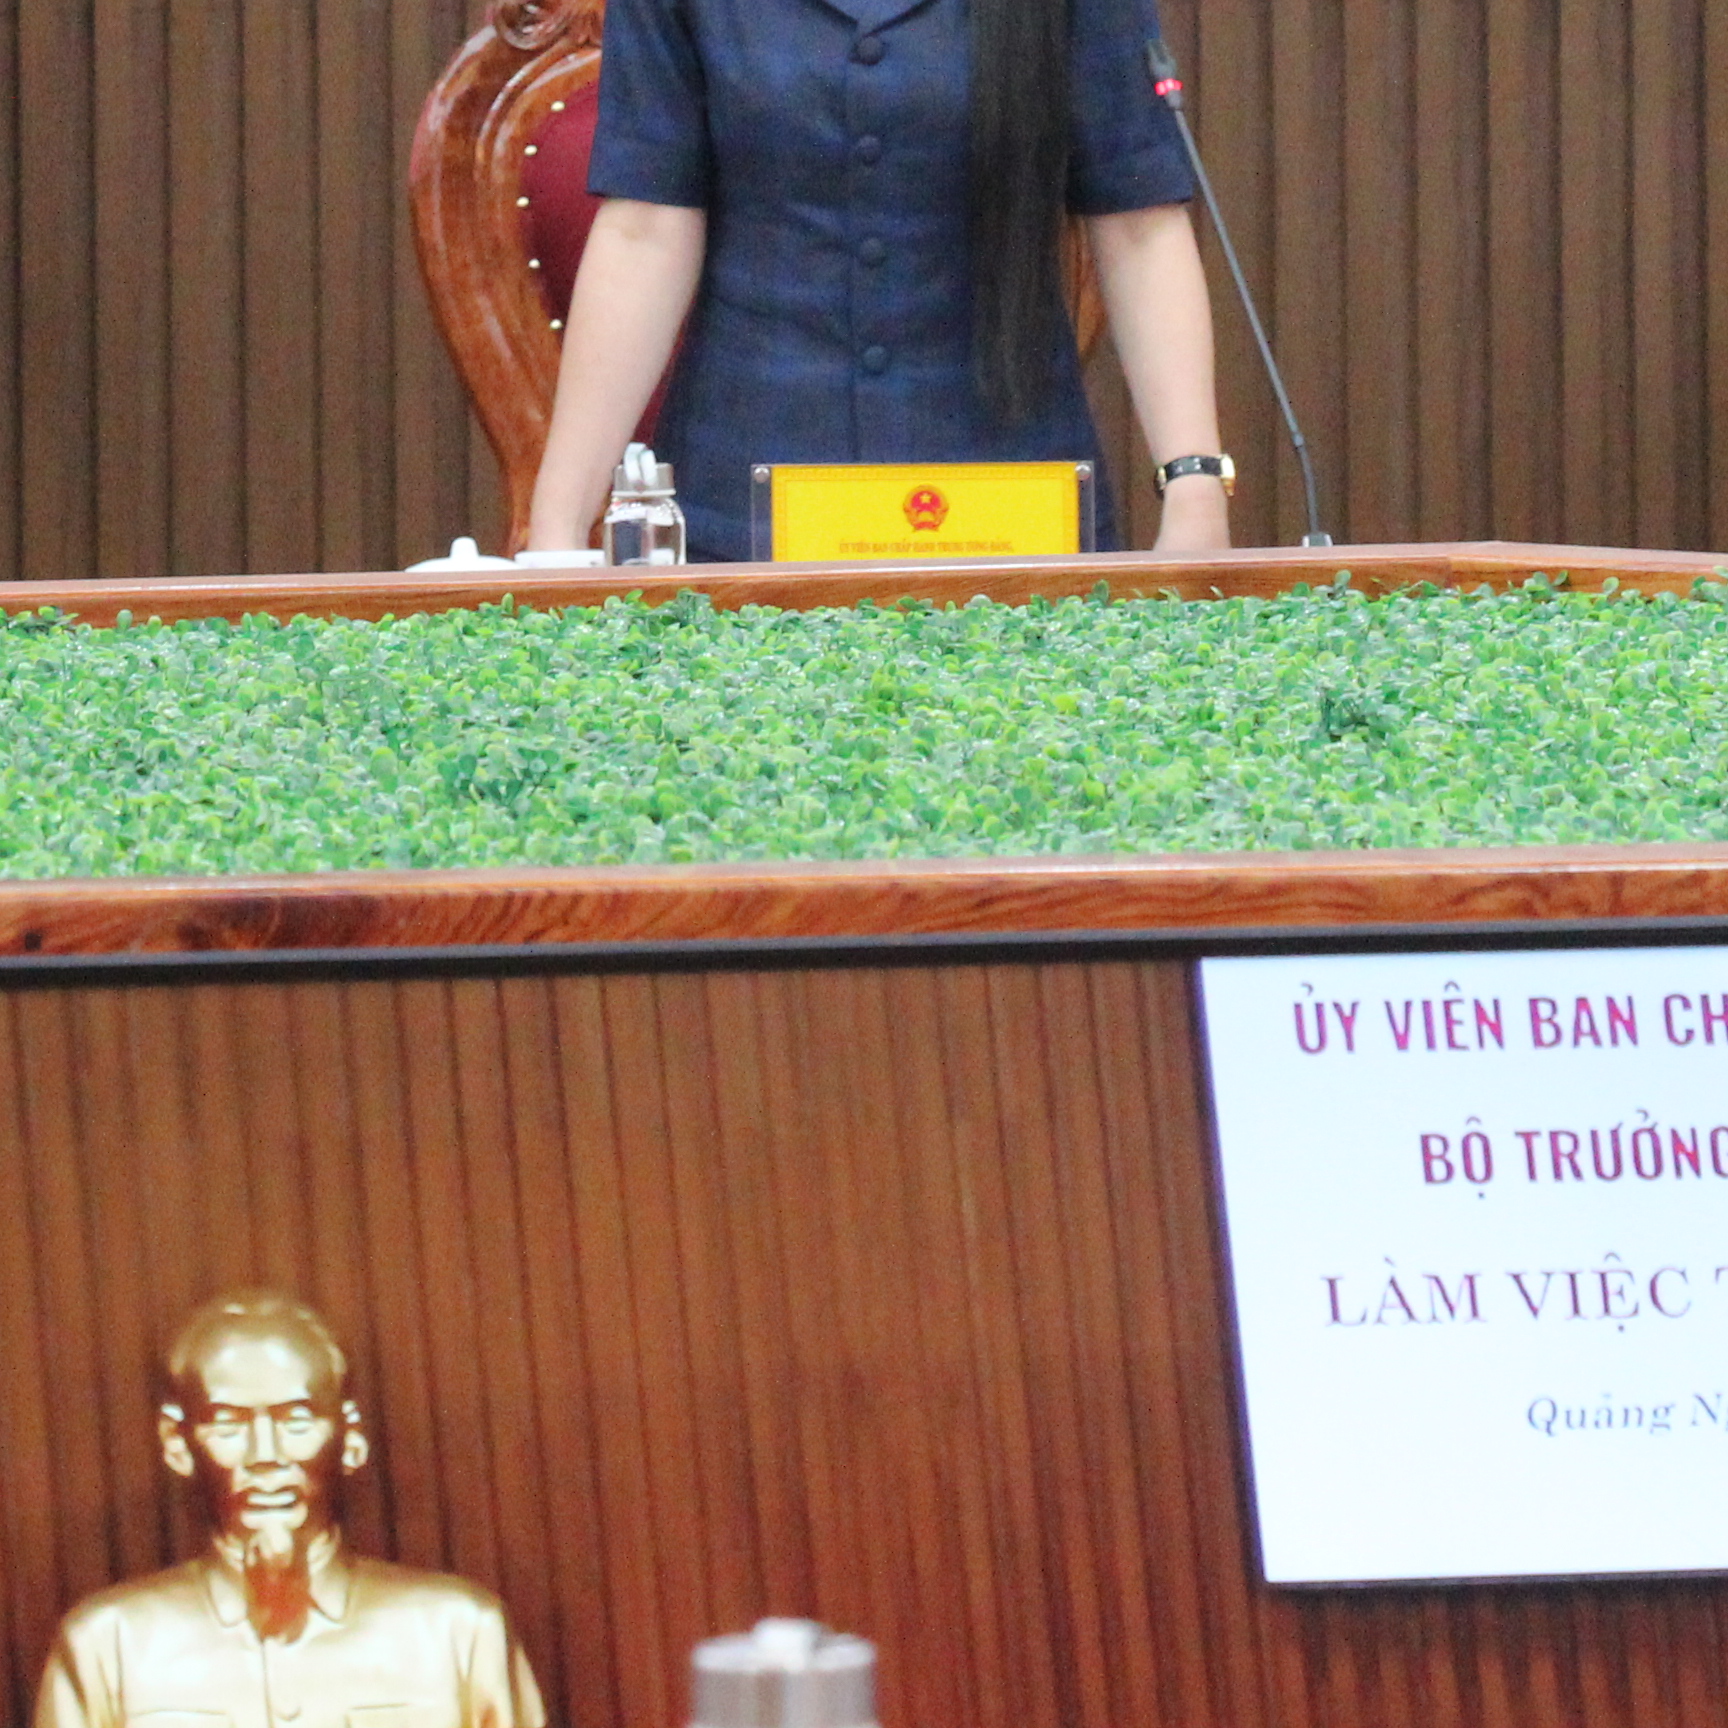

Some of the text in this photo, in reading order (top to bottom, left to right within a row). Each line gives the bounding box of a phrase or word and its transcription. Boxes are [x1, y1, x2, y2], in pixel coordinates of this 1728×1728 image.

[1293, 984, 1360, 1054] ỦY
[1384, 982, 1506, 1052] VIÊN
[1529, 994, 1639, 1048] BAN
[1420, 1116, 1494, 1199] BỘ
[1323, 1257, 1482, 1327] LÀM
[1506, 1252, 1692, 1332] VIỆC
[1526, 1392, 1675, 1437] Quảng
